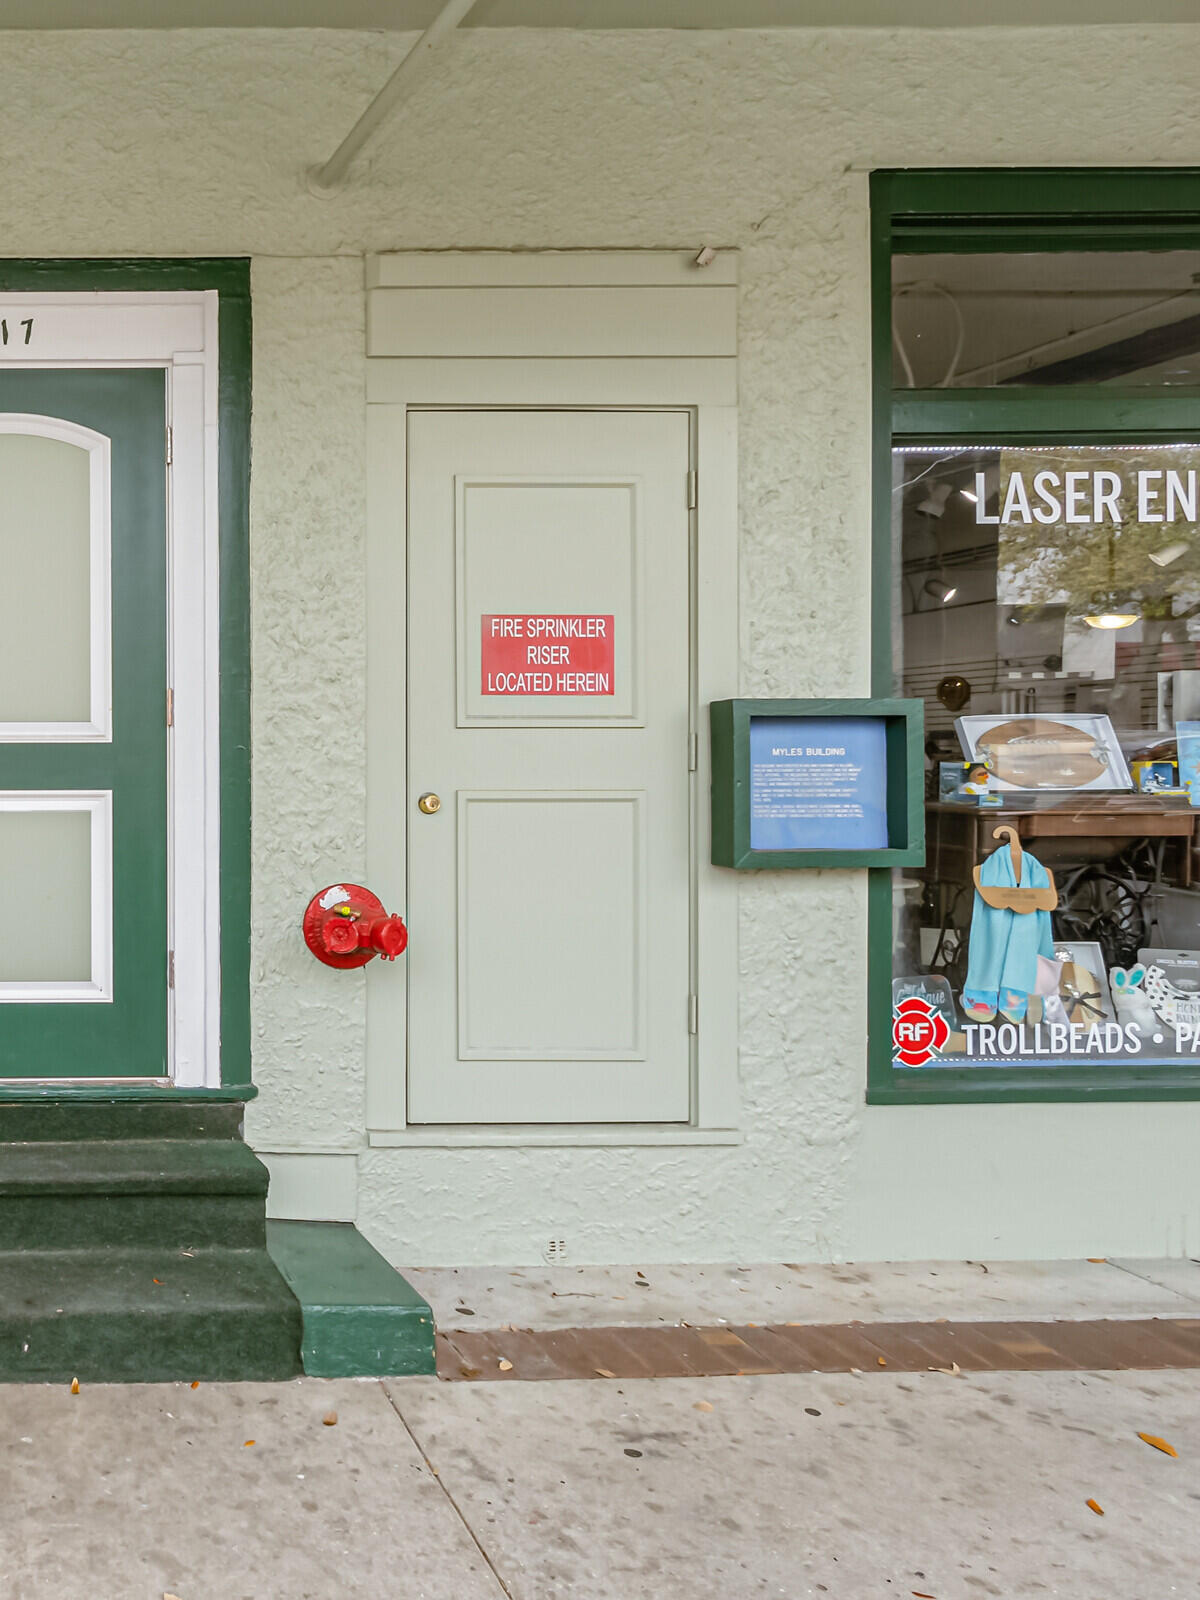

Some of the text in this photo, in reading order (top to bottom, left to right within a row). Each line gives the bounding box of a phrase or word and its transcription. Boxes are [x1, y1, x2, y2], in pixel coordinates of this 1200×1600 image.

[975, 470, 1196, 524] LASER EN
[491, 618, 606, 637] FIRE SPRINKLER
[527, 645, 570, 664] RISER
[487, 672, 609, 692] LOCATED HEREIN
[772, 747, 846, 756] MYLES BUILDING
[898, 1022, 930, 1042] RF
[960, 1022, 1142, 1056] TROLLBEADS
